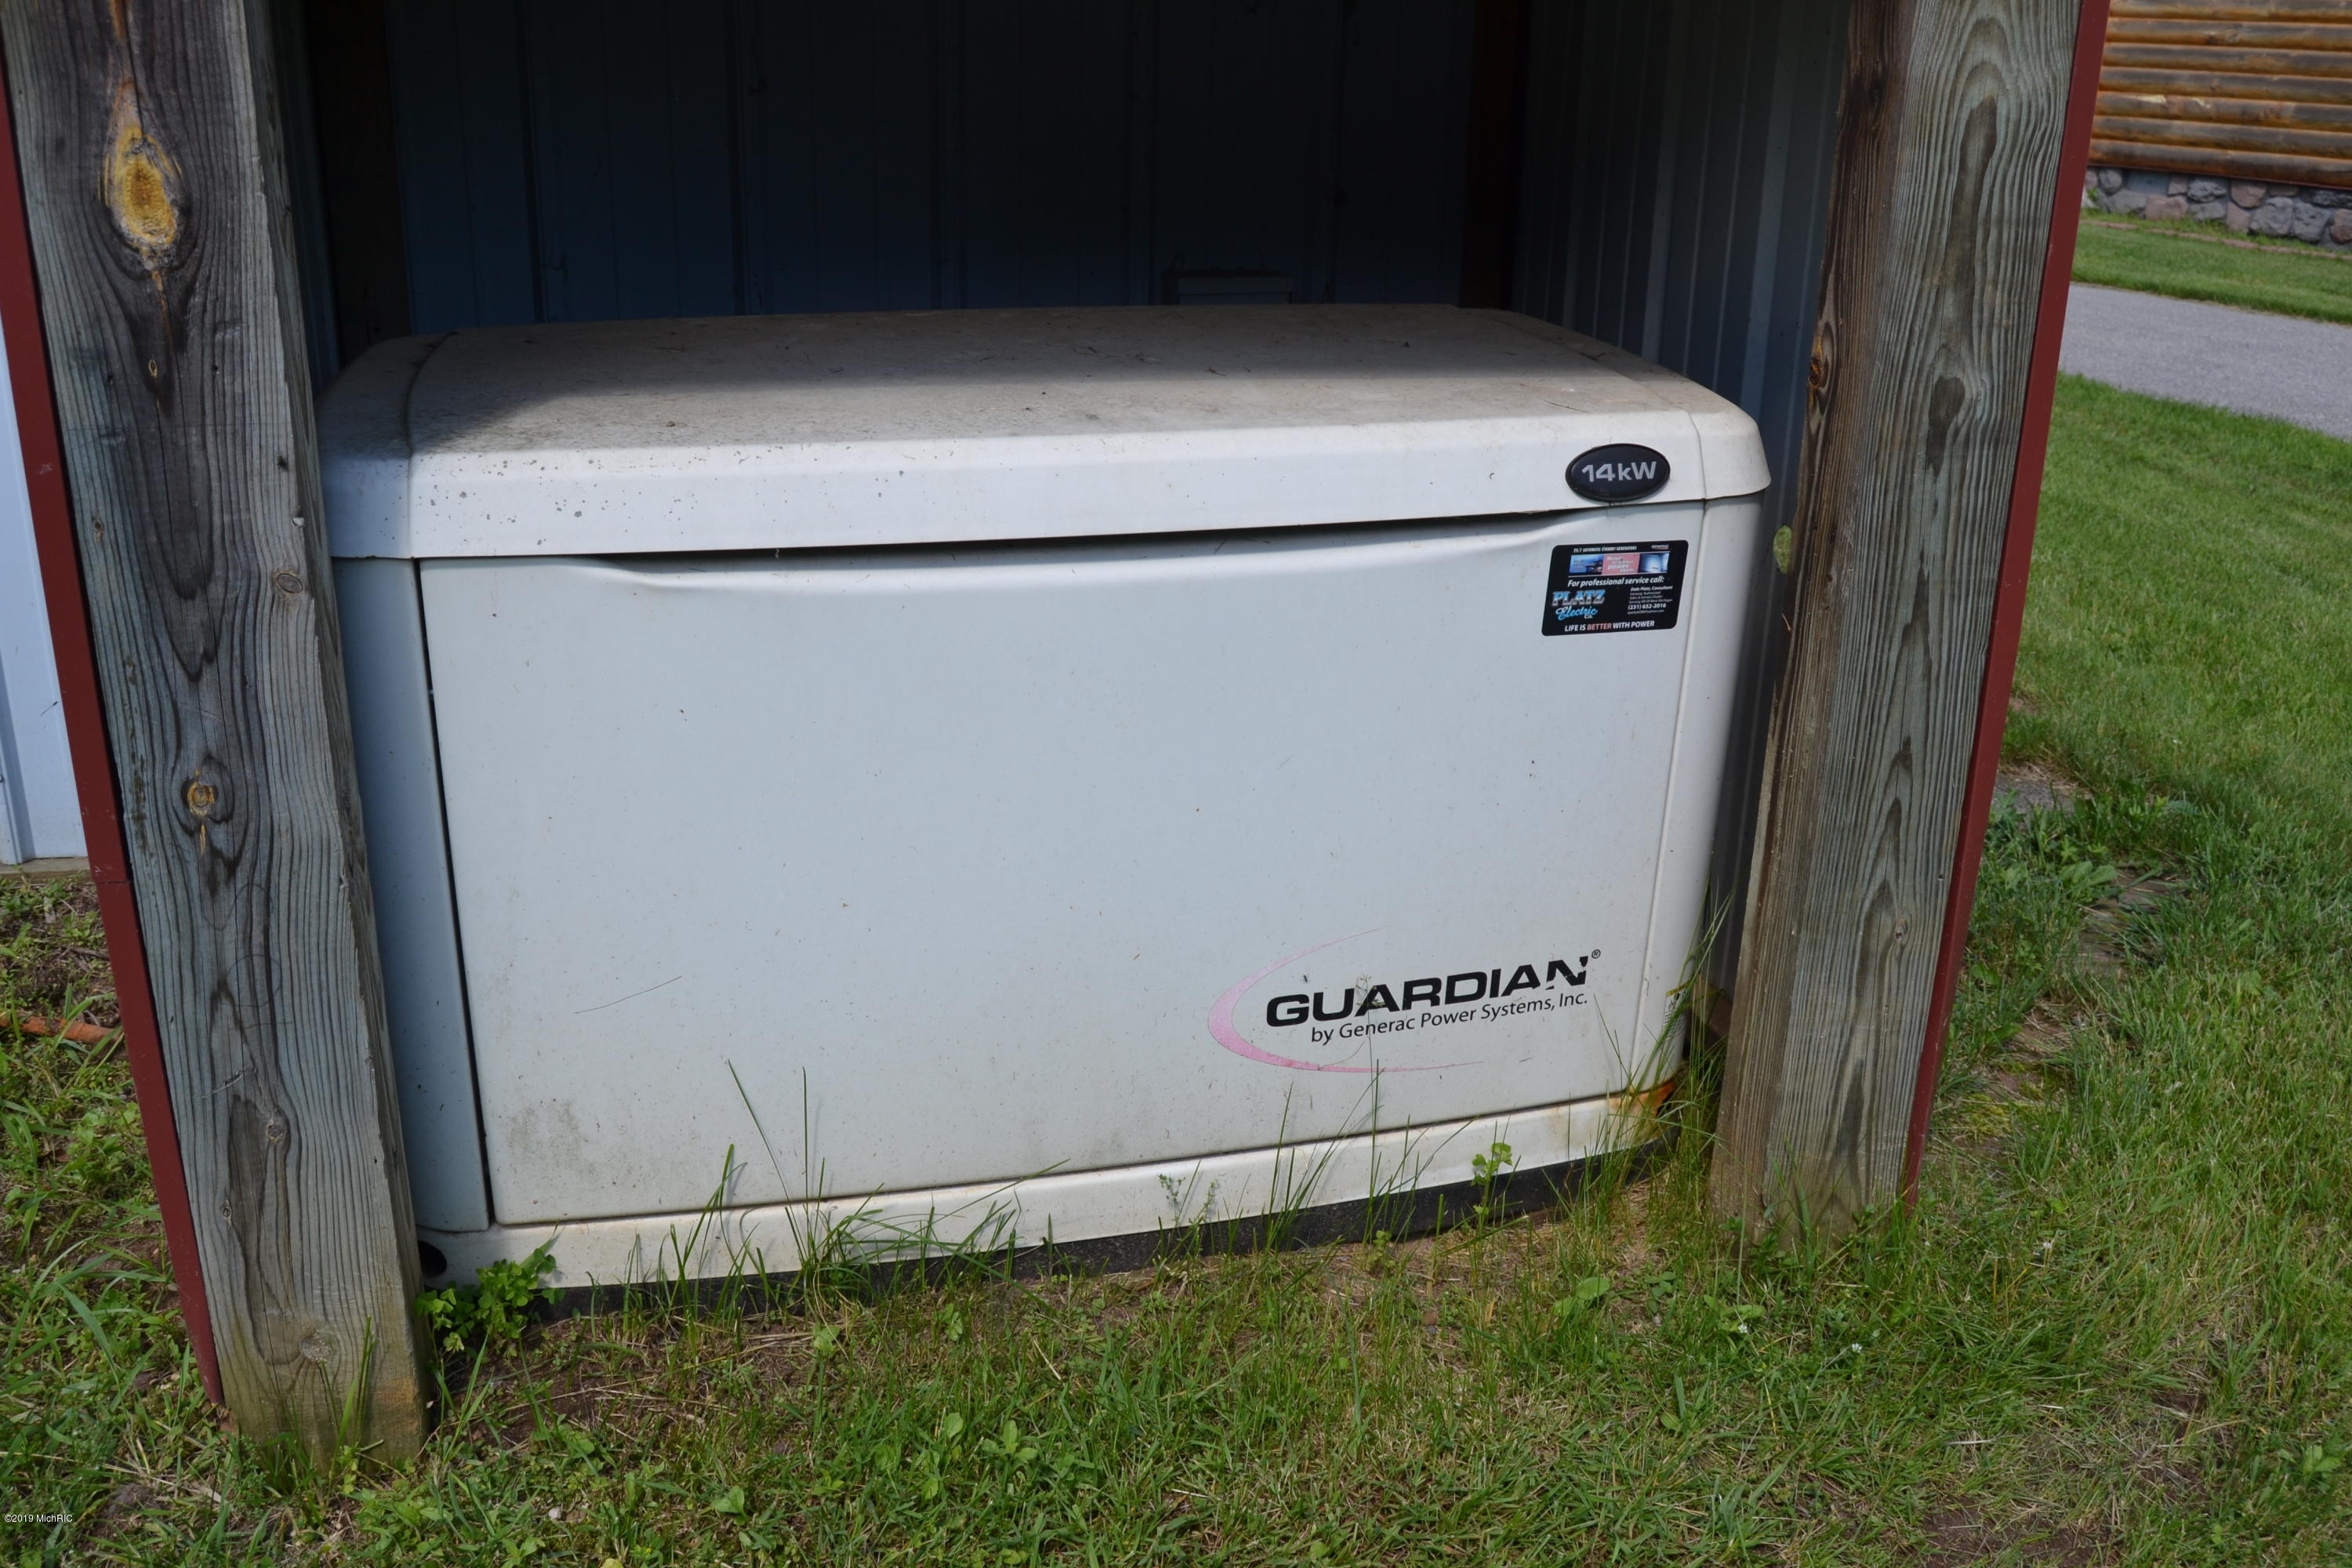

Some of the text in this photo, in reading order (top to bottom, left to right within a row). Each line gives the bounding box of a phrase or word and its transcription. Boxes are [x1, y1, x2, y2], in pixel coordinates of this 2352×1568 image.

[1582, 461, 1657, 483] 14kW
[1580, 576, 1624, 588] professional
[1552, 590, 1606, 606] PLATZ
[1555, 605, 1599, 621] Electric
[1613, 621, 1630, 630] WITH
[1310, 990, 1588, 1047] by Generac Power Systems, Inc.
